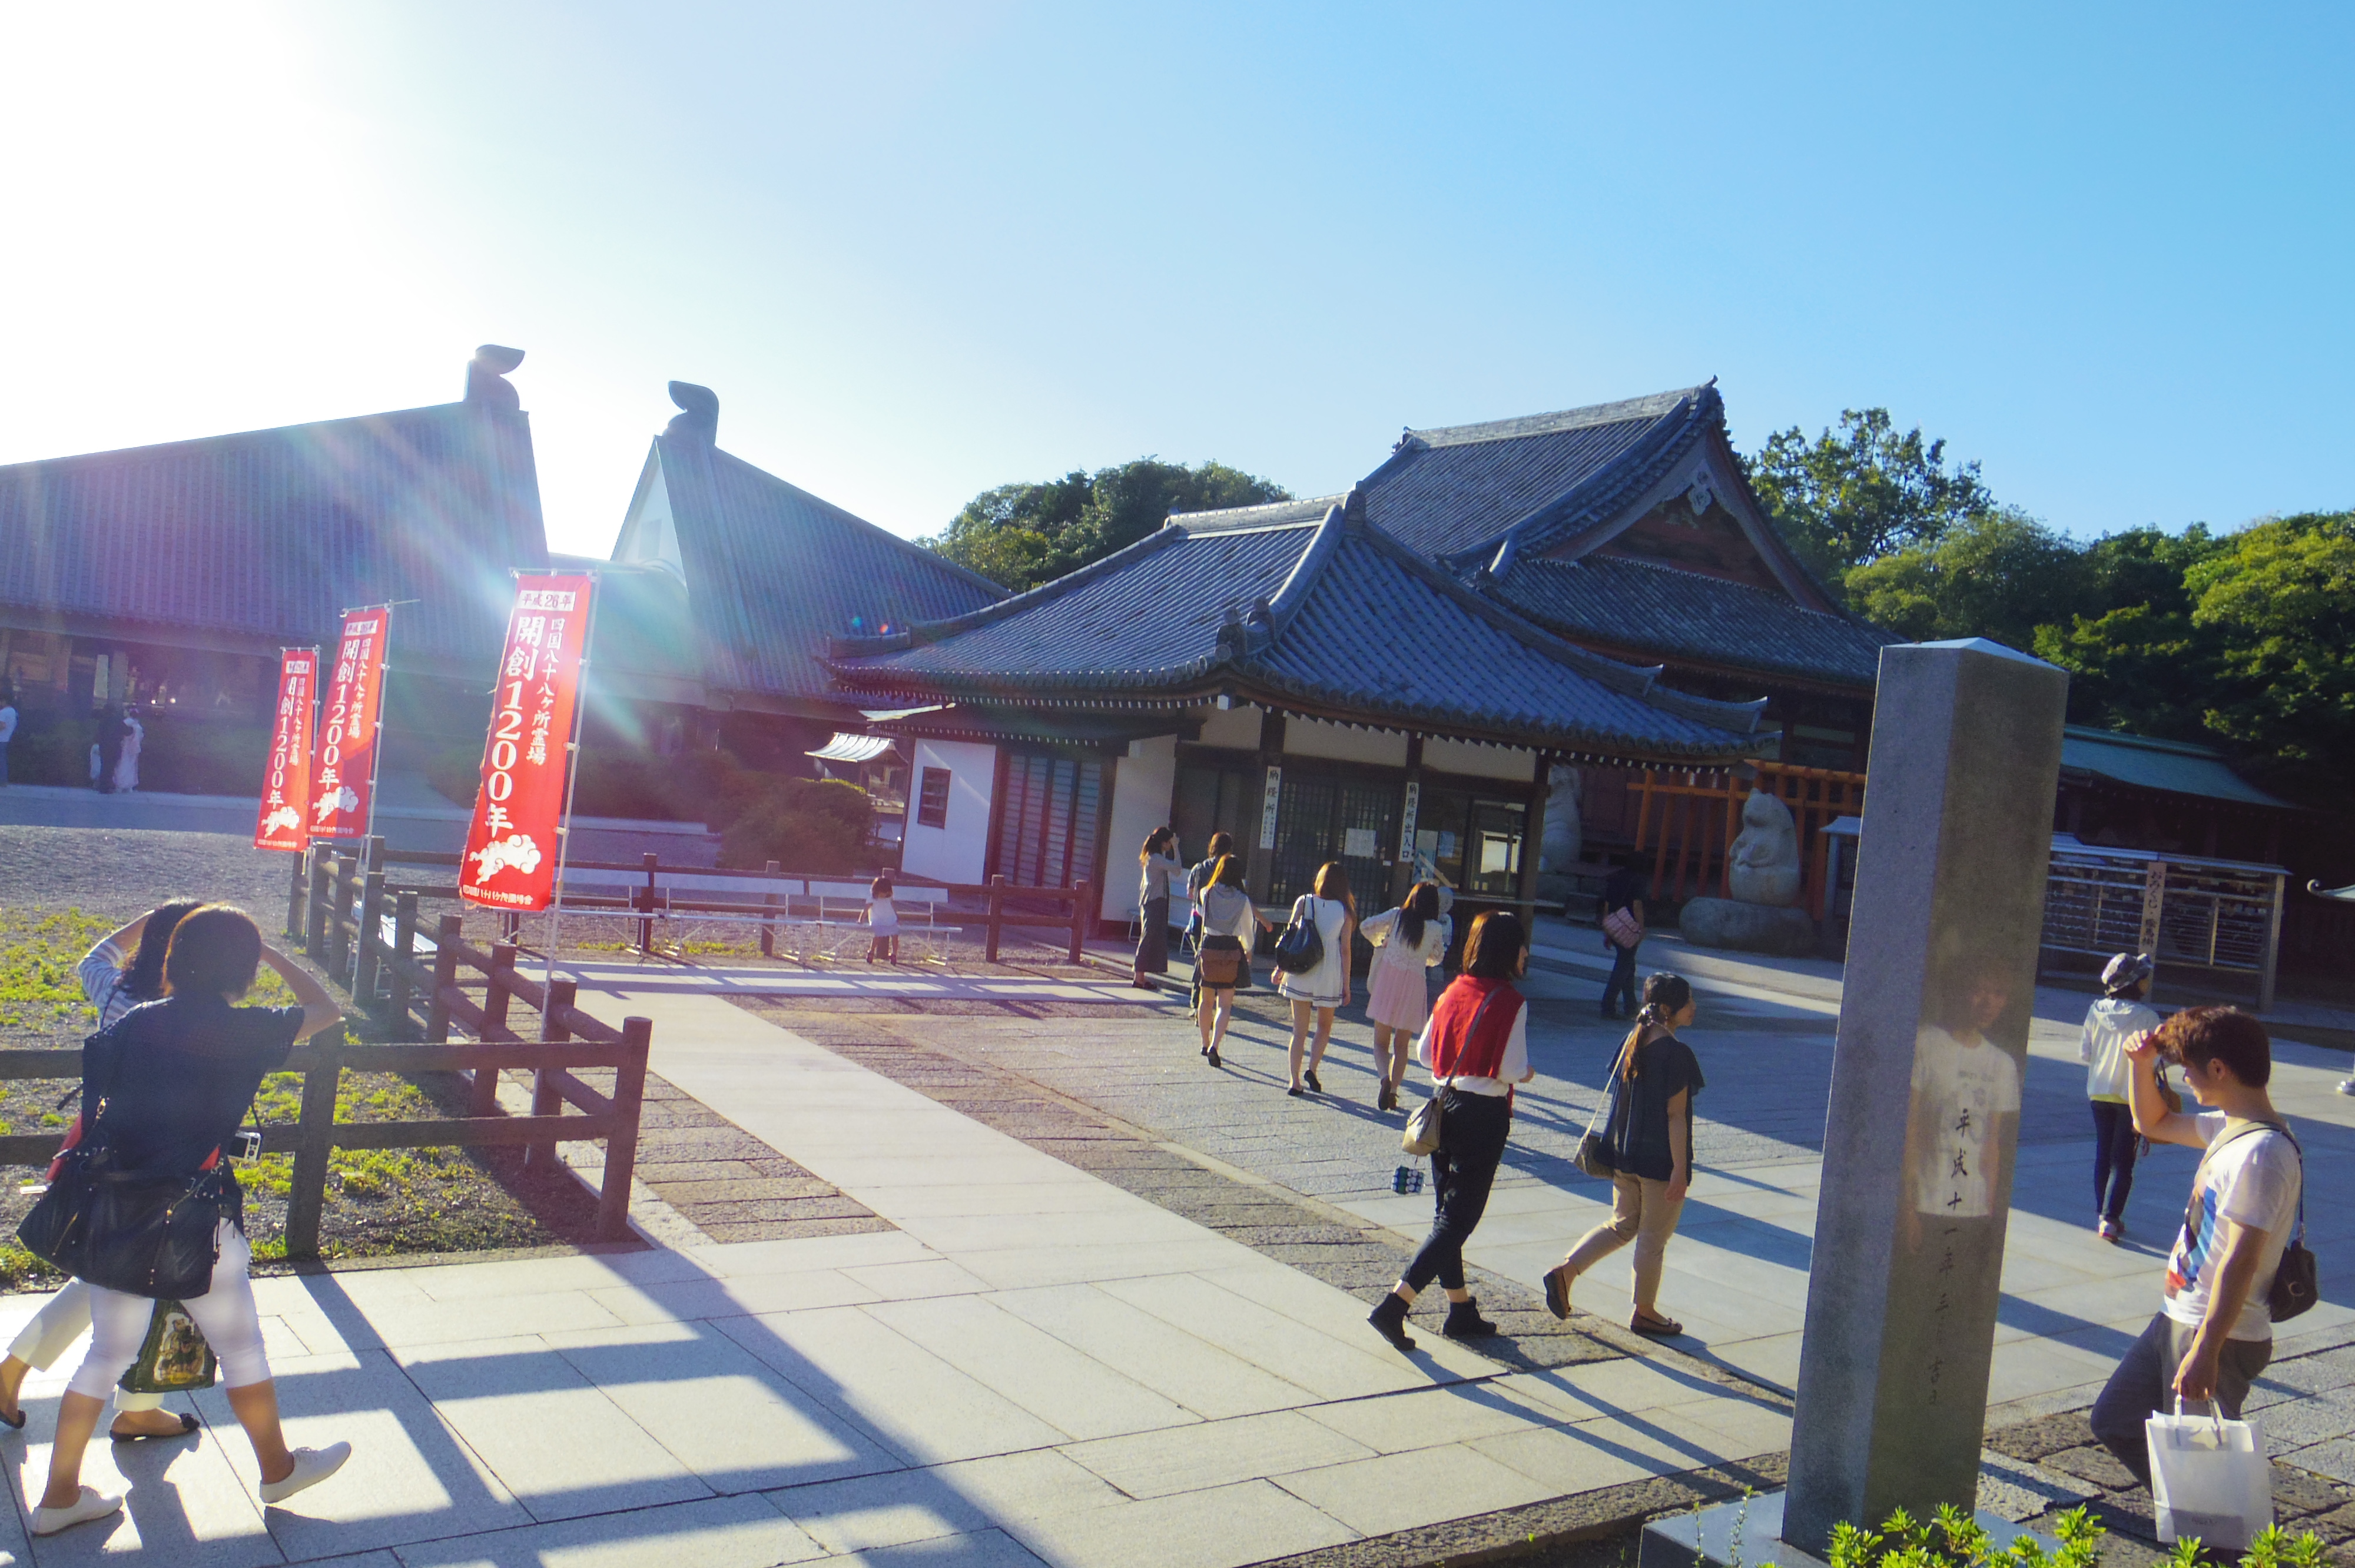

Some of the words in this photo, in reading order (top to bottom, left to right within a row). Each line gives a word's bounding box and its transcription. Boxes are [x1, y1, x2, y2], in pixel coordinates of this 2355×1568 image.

[522, 593, 572, 609] 平成26年
[318, 639, 360, 790] 開創1200年
[485, 616, 546, 838] 開創1200年
[526, 617, 565, 766] 四国八十八ヶ所霊場
[1265, 769, 1279, 815] 納経所
[1402, 784, 1417, 858] 納経所出入口
